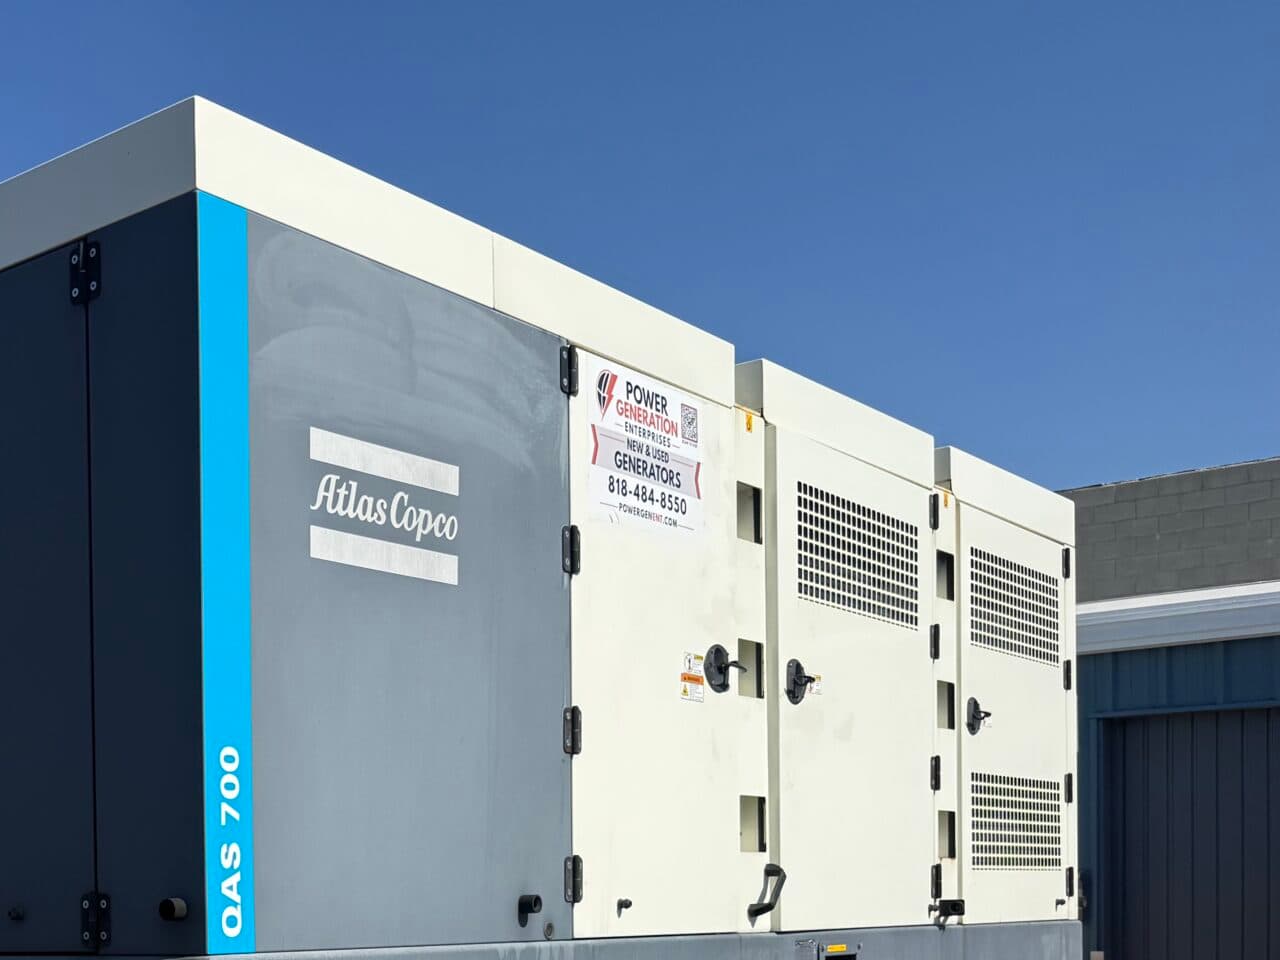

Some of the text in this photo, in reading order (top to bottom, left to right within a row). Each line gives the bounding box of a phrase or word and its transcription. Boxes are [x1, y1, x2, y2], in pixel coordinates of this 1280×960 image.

[625, 381, 669, 416] POWER
[616, 399, 678, 437] GENERATION
[624, 422, 671, 448] ENTERPRISES
[626, 438, 670, 463] NEW & USED
[614, 451, 681, 489] GENERATORS
[310, 473, 459, 542] Atlas Copco
[608, 475, 687, 515] 818-484-8550
[618, 503, 678, 527] POWERGENENT.COM
[219, 746, 242, 938] QAS 700
